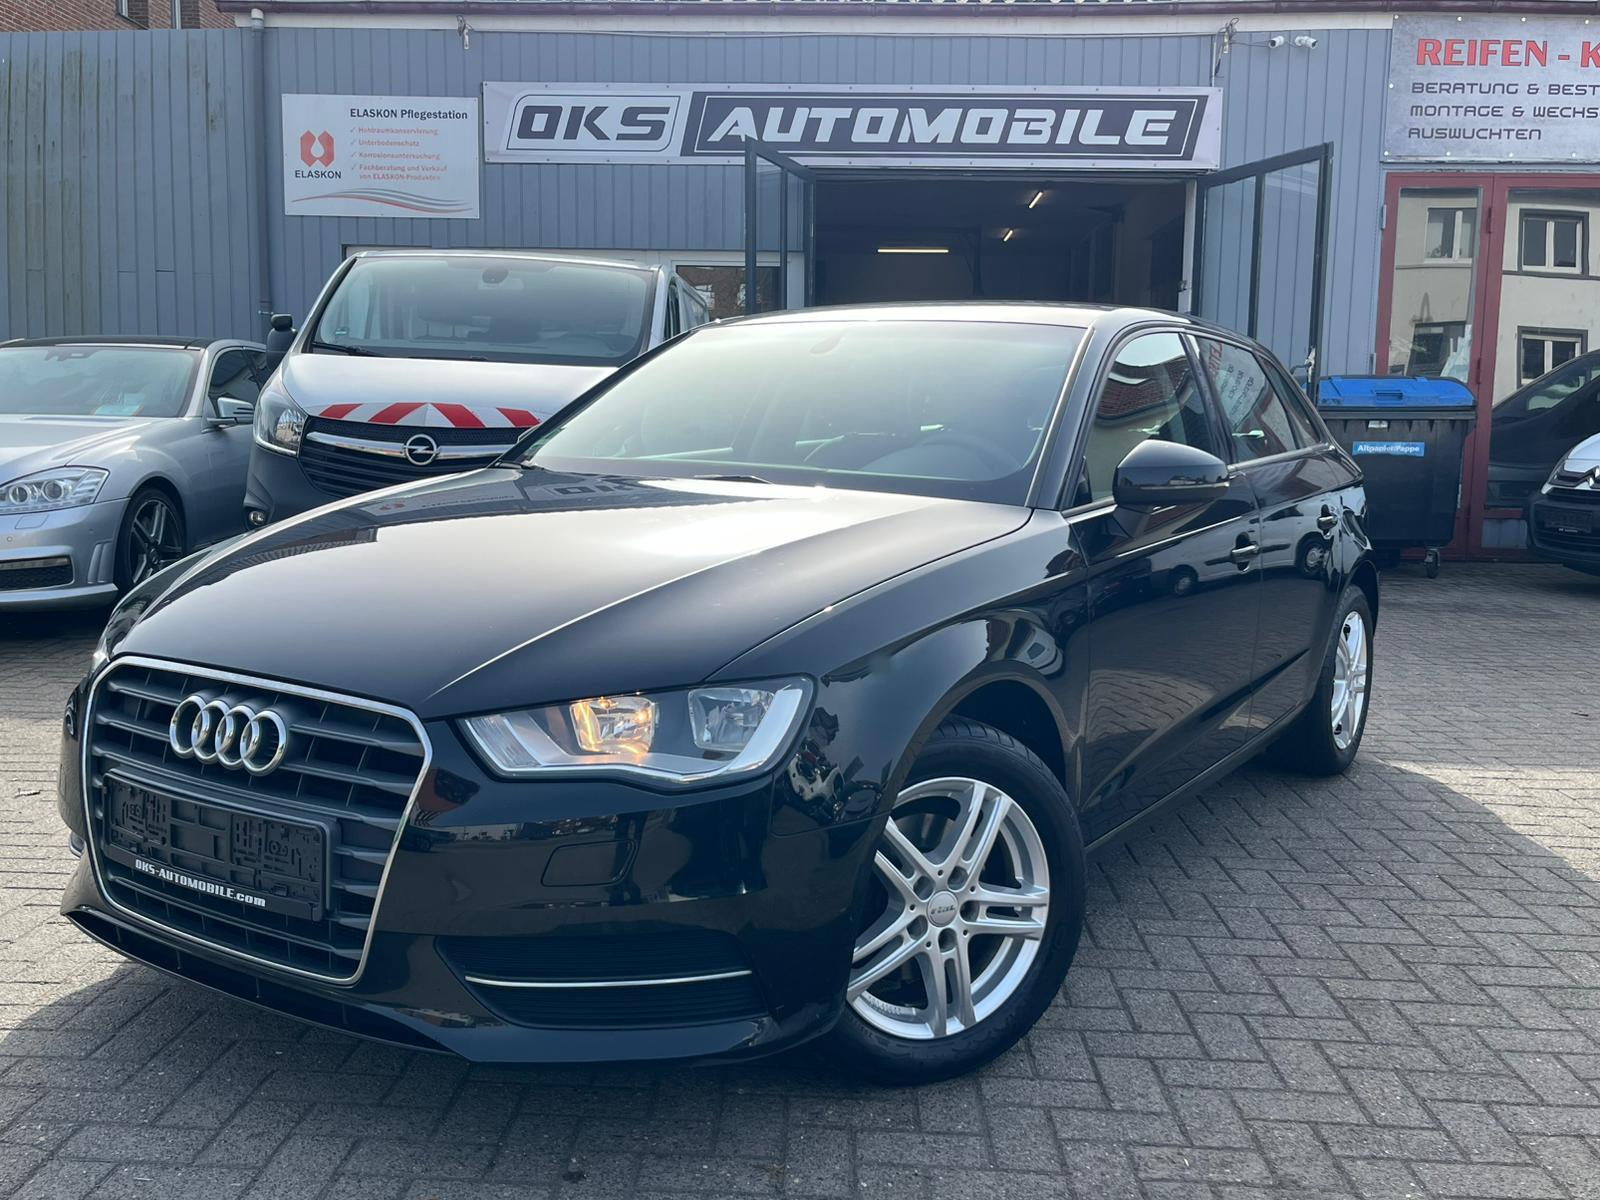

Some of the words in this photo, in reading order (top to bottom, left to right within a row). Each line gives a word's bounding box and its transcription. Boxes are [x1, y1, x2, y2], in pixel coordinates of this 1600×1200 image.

[1416, 38, 1548, 67] REIFEN
[1411, 82, 1519, 95] BERATUNG
[1527, 83, 1539, 95] &
[1548, 83, 1600, 96] BEST
[350, 108, 398, 118] ELASKON
[400, 109, 468, 121] Pflegestation
[1410, 105, 1504, 117] MONTAGE
[1512, 105, 1524, 117] &
[1533, 106, 1600, 119] WECHS
[517, 105, 671, 141] OKS
[707, 106, 1177, 146] AUTOMOBILE
[1408, 127, 1542, 140] AUSWUCHTEN
[294, 169, 342, 180] ELASKON
[135, 858, 266, 908] OKS-AUTOMOBILE.com
